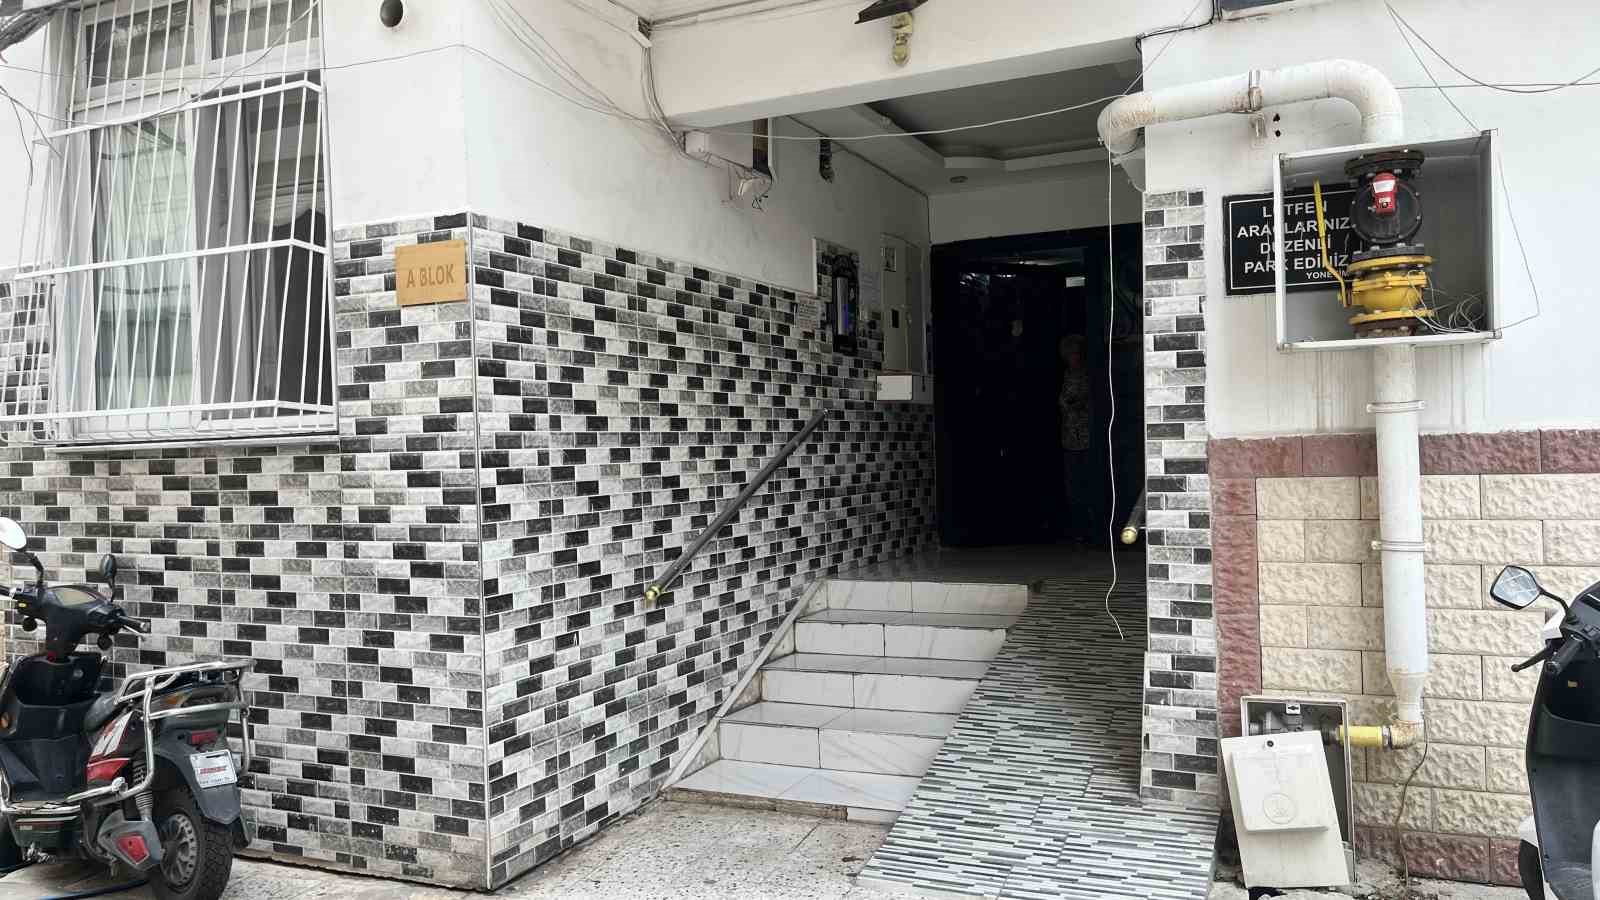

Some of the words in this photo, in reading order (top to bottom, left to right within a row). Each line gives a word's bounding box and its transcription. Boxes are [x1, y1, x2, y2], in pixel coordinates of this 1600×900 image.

[1263, 200, 1326, 217] LTFE
[1237, 217, 1350, 238] ARALARNIZ
[1260, 234, 1331, 254] DZENLİ
[406, 269, 416, 288] A
[420, 263, 455, 287] BLOK
